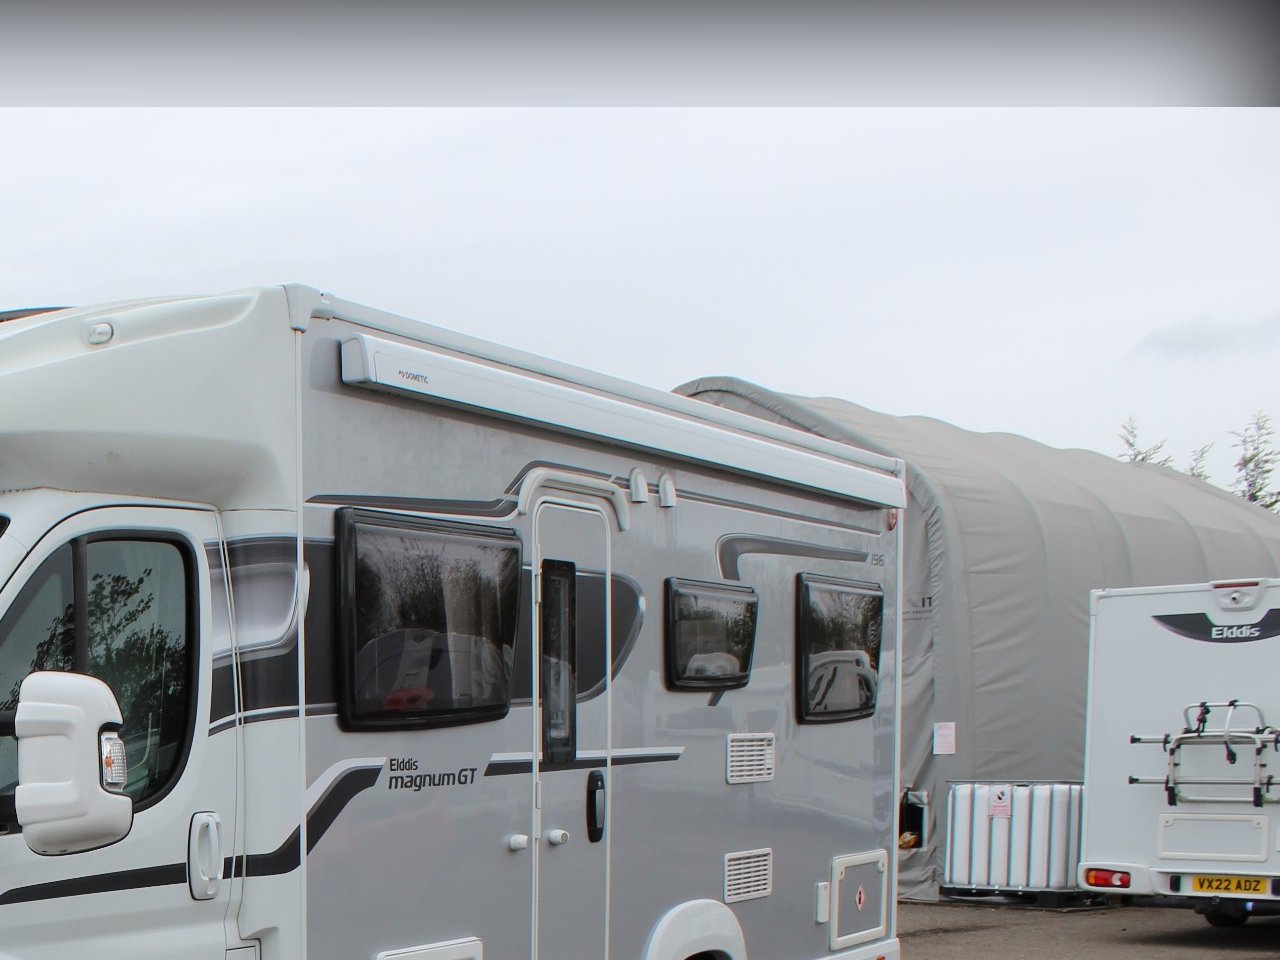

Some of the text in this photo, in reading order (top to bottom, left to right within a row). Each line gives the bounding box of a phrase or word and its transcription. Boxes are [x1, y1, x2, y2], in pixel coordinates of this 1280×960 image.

[871, 553, 885, 567] 196
[1211, 625, 1261, 639] Elddis
[389, 758, 418, 772] Elddis
[388, 768, 477, 792] magnum GT
[1198, 878, 1261, 892] VX22 ADZ
